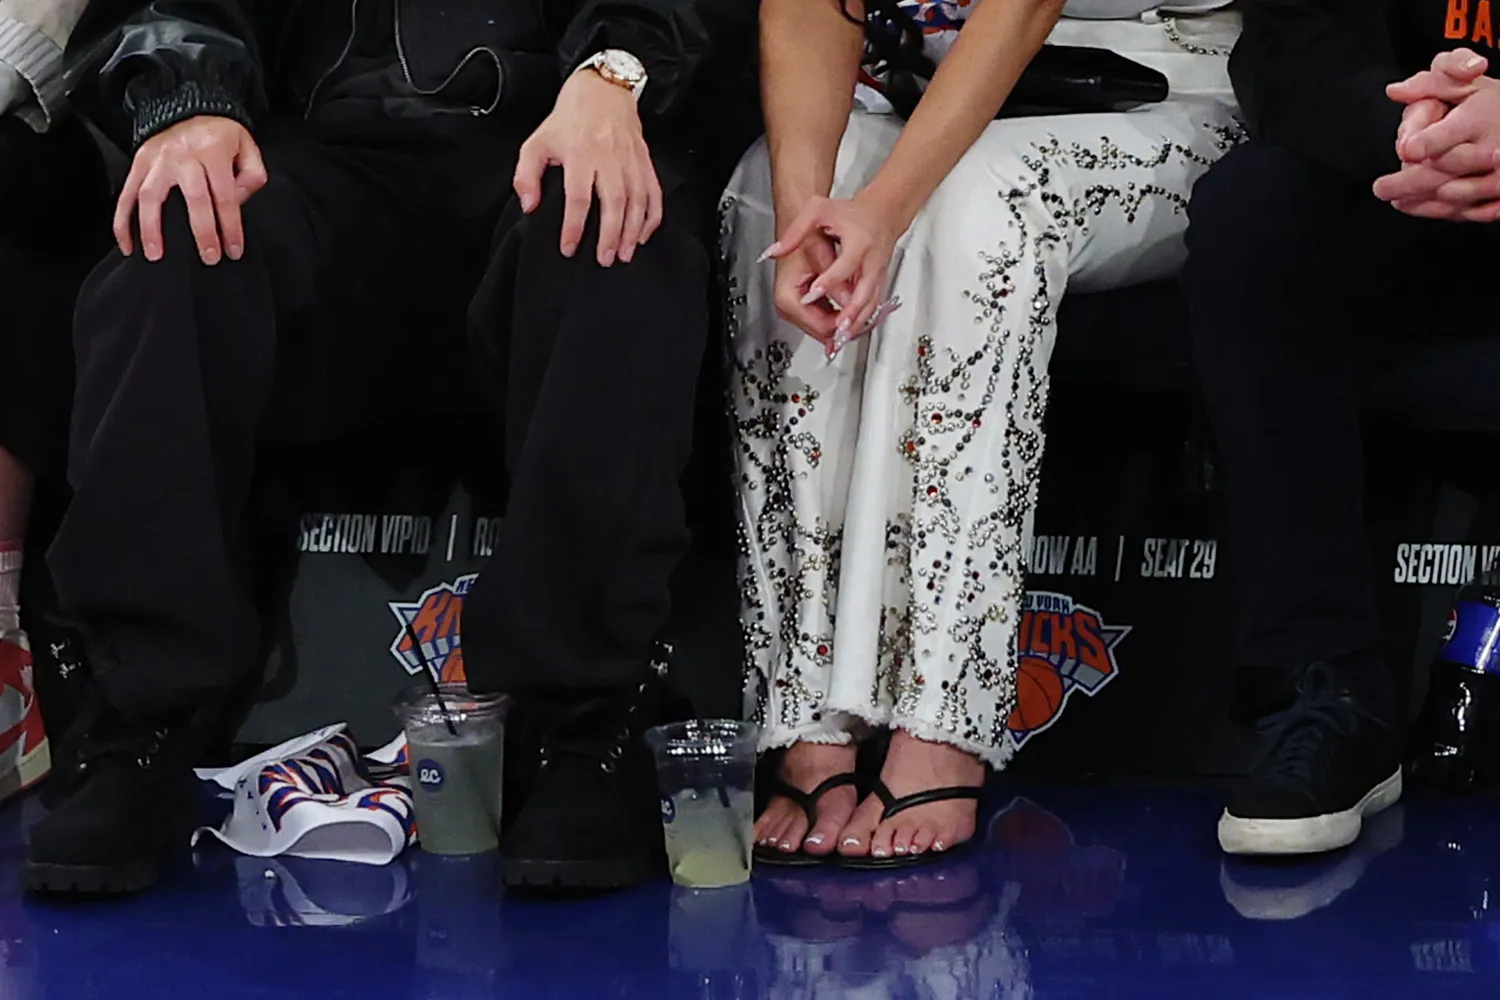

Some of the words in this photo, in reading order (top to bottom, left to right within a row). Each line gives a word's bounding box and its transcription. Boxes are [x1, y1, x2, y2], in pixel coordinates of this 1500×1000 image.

[297, 512, 377, 553] SECTION
[1070, 536, 1098, 576] AA
[1140, 538, 1190, 578] SEAT
[1190, 539, 1218, 579] 29
[1394, 543, 1477, 585] SECTION
